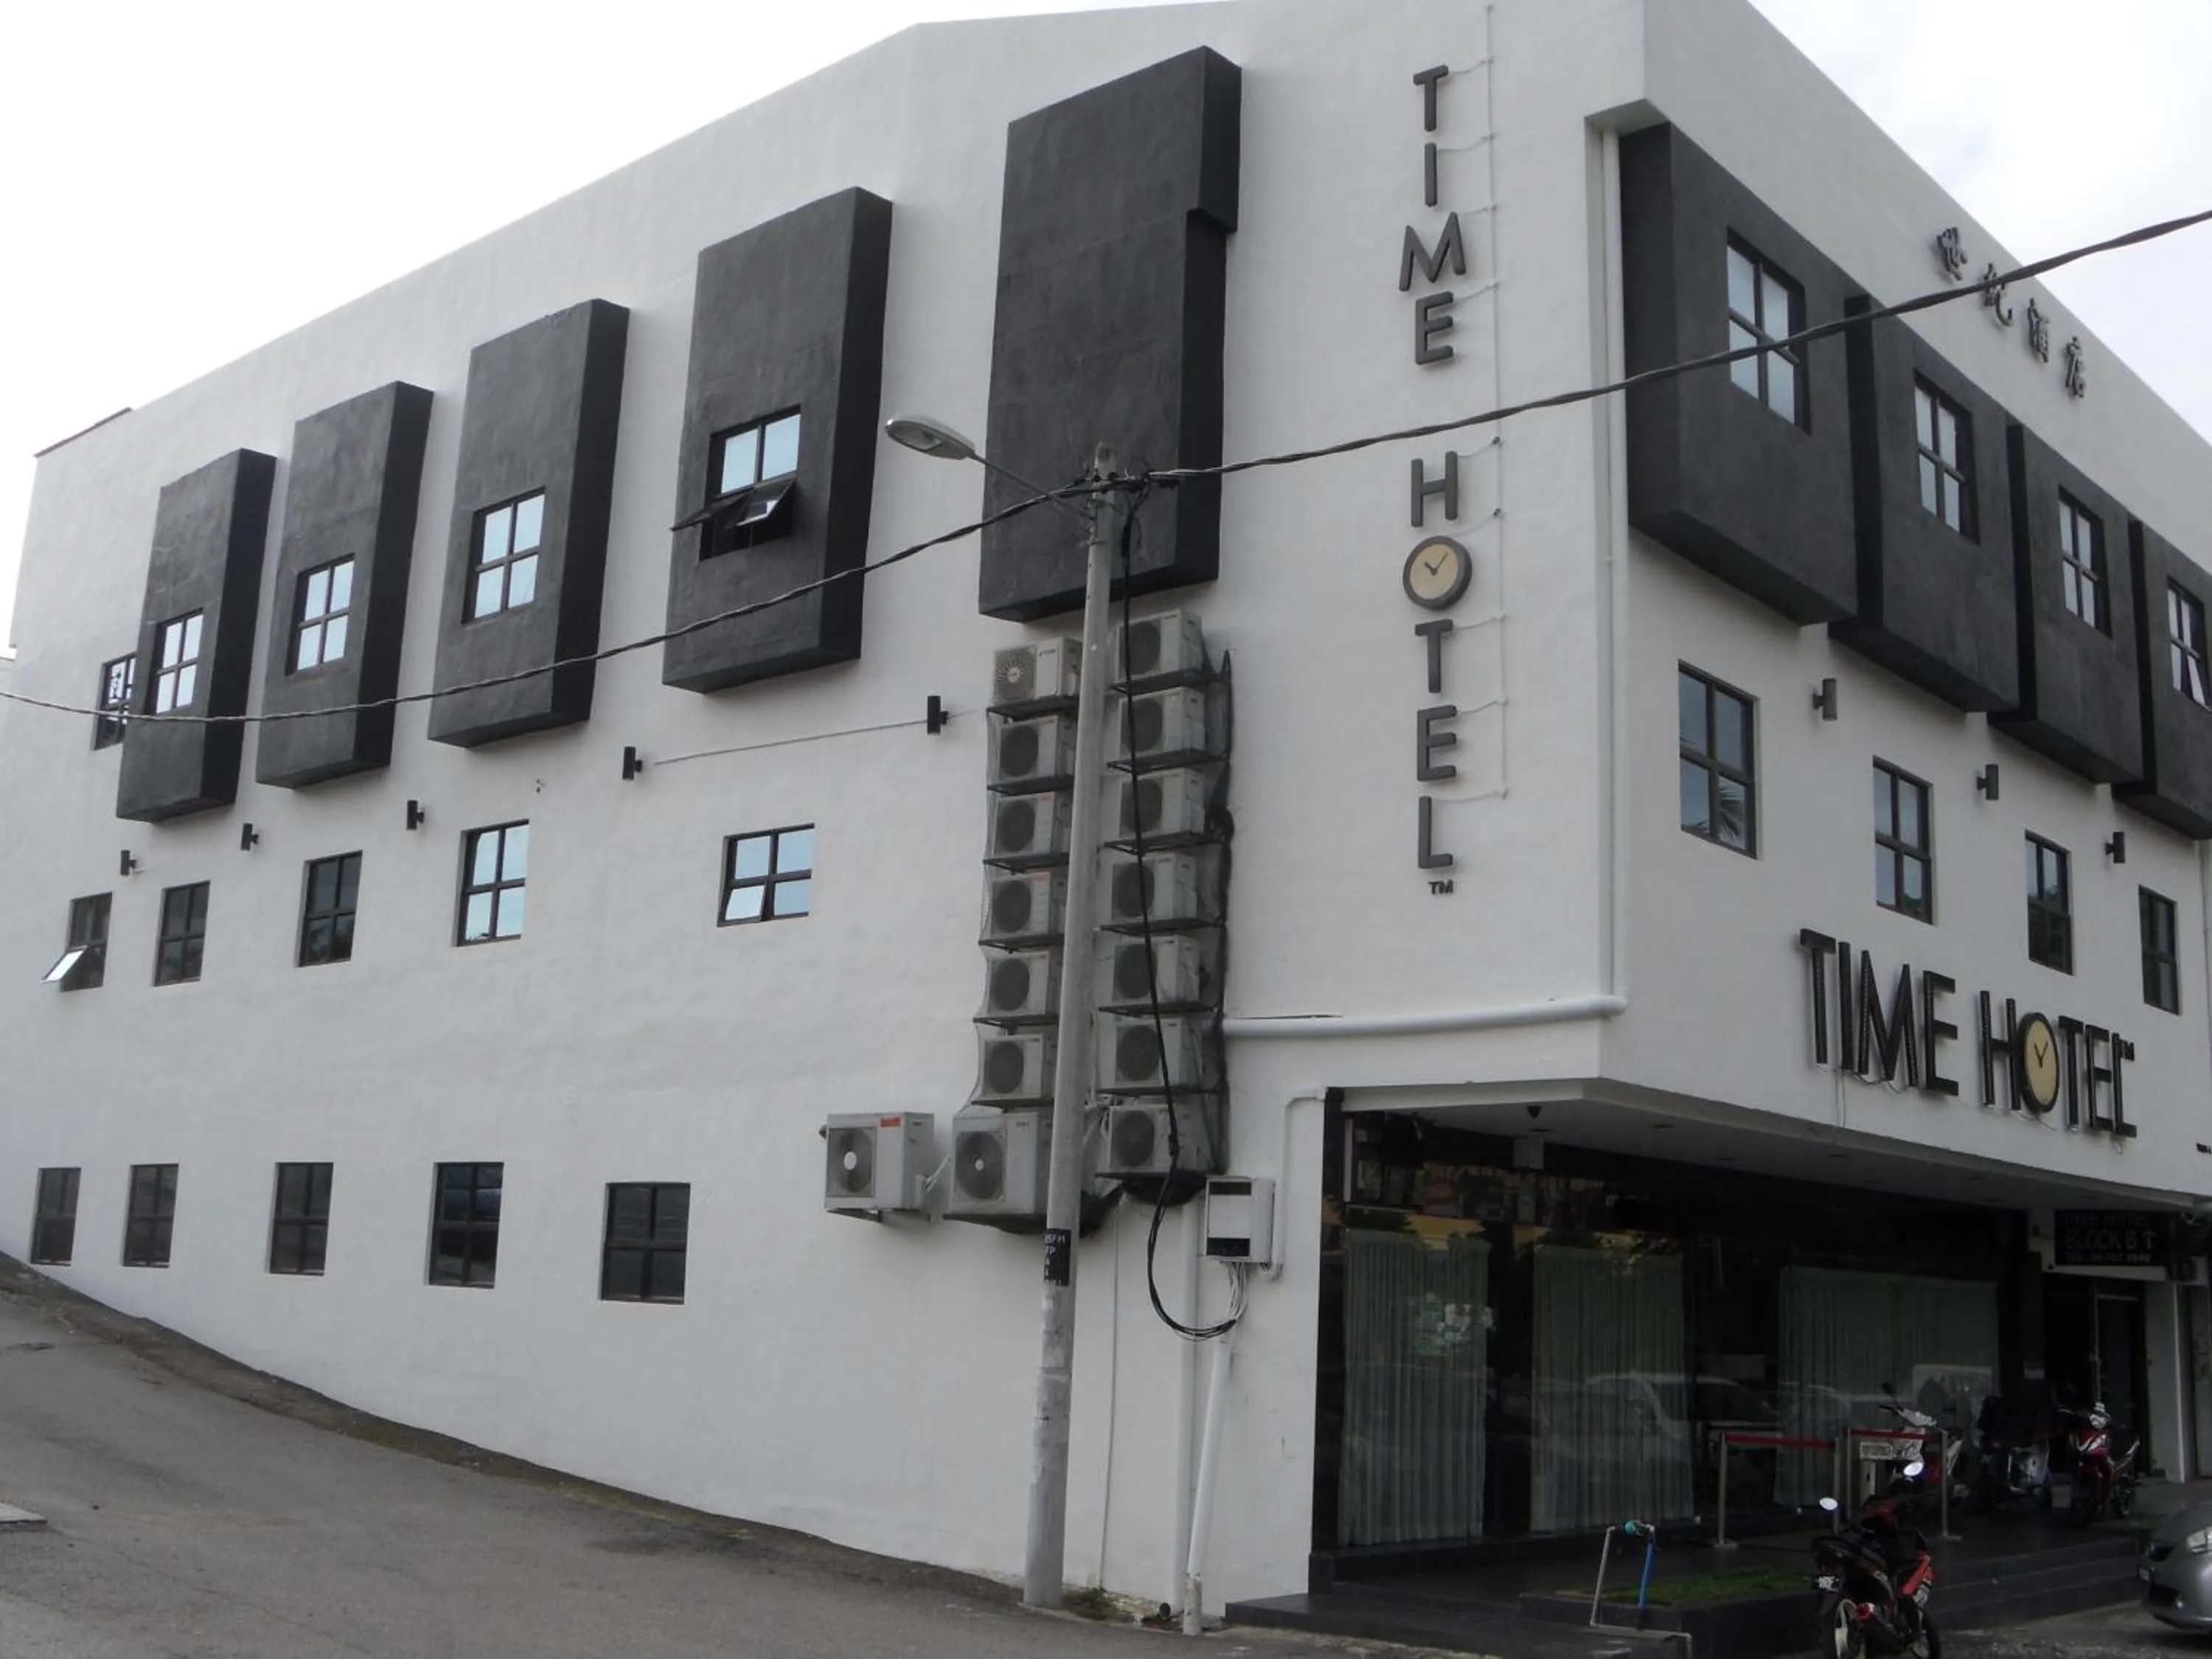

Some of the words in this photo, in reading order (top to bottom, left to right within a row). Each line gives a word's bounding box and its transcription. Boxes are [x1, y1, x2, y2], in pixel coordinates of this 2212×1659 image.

[1399, 64, 1467, 366] TIME
[1800, 928, 1959, 1096] TIME
[1980, 990, 2138, 1138] HOTEL
